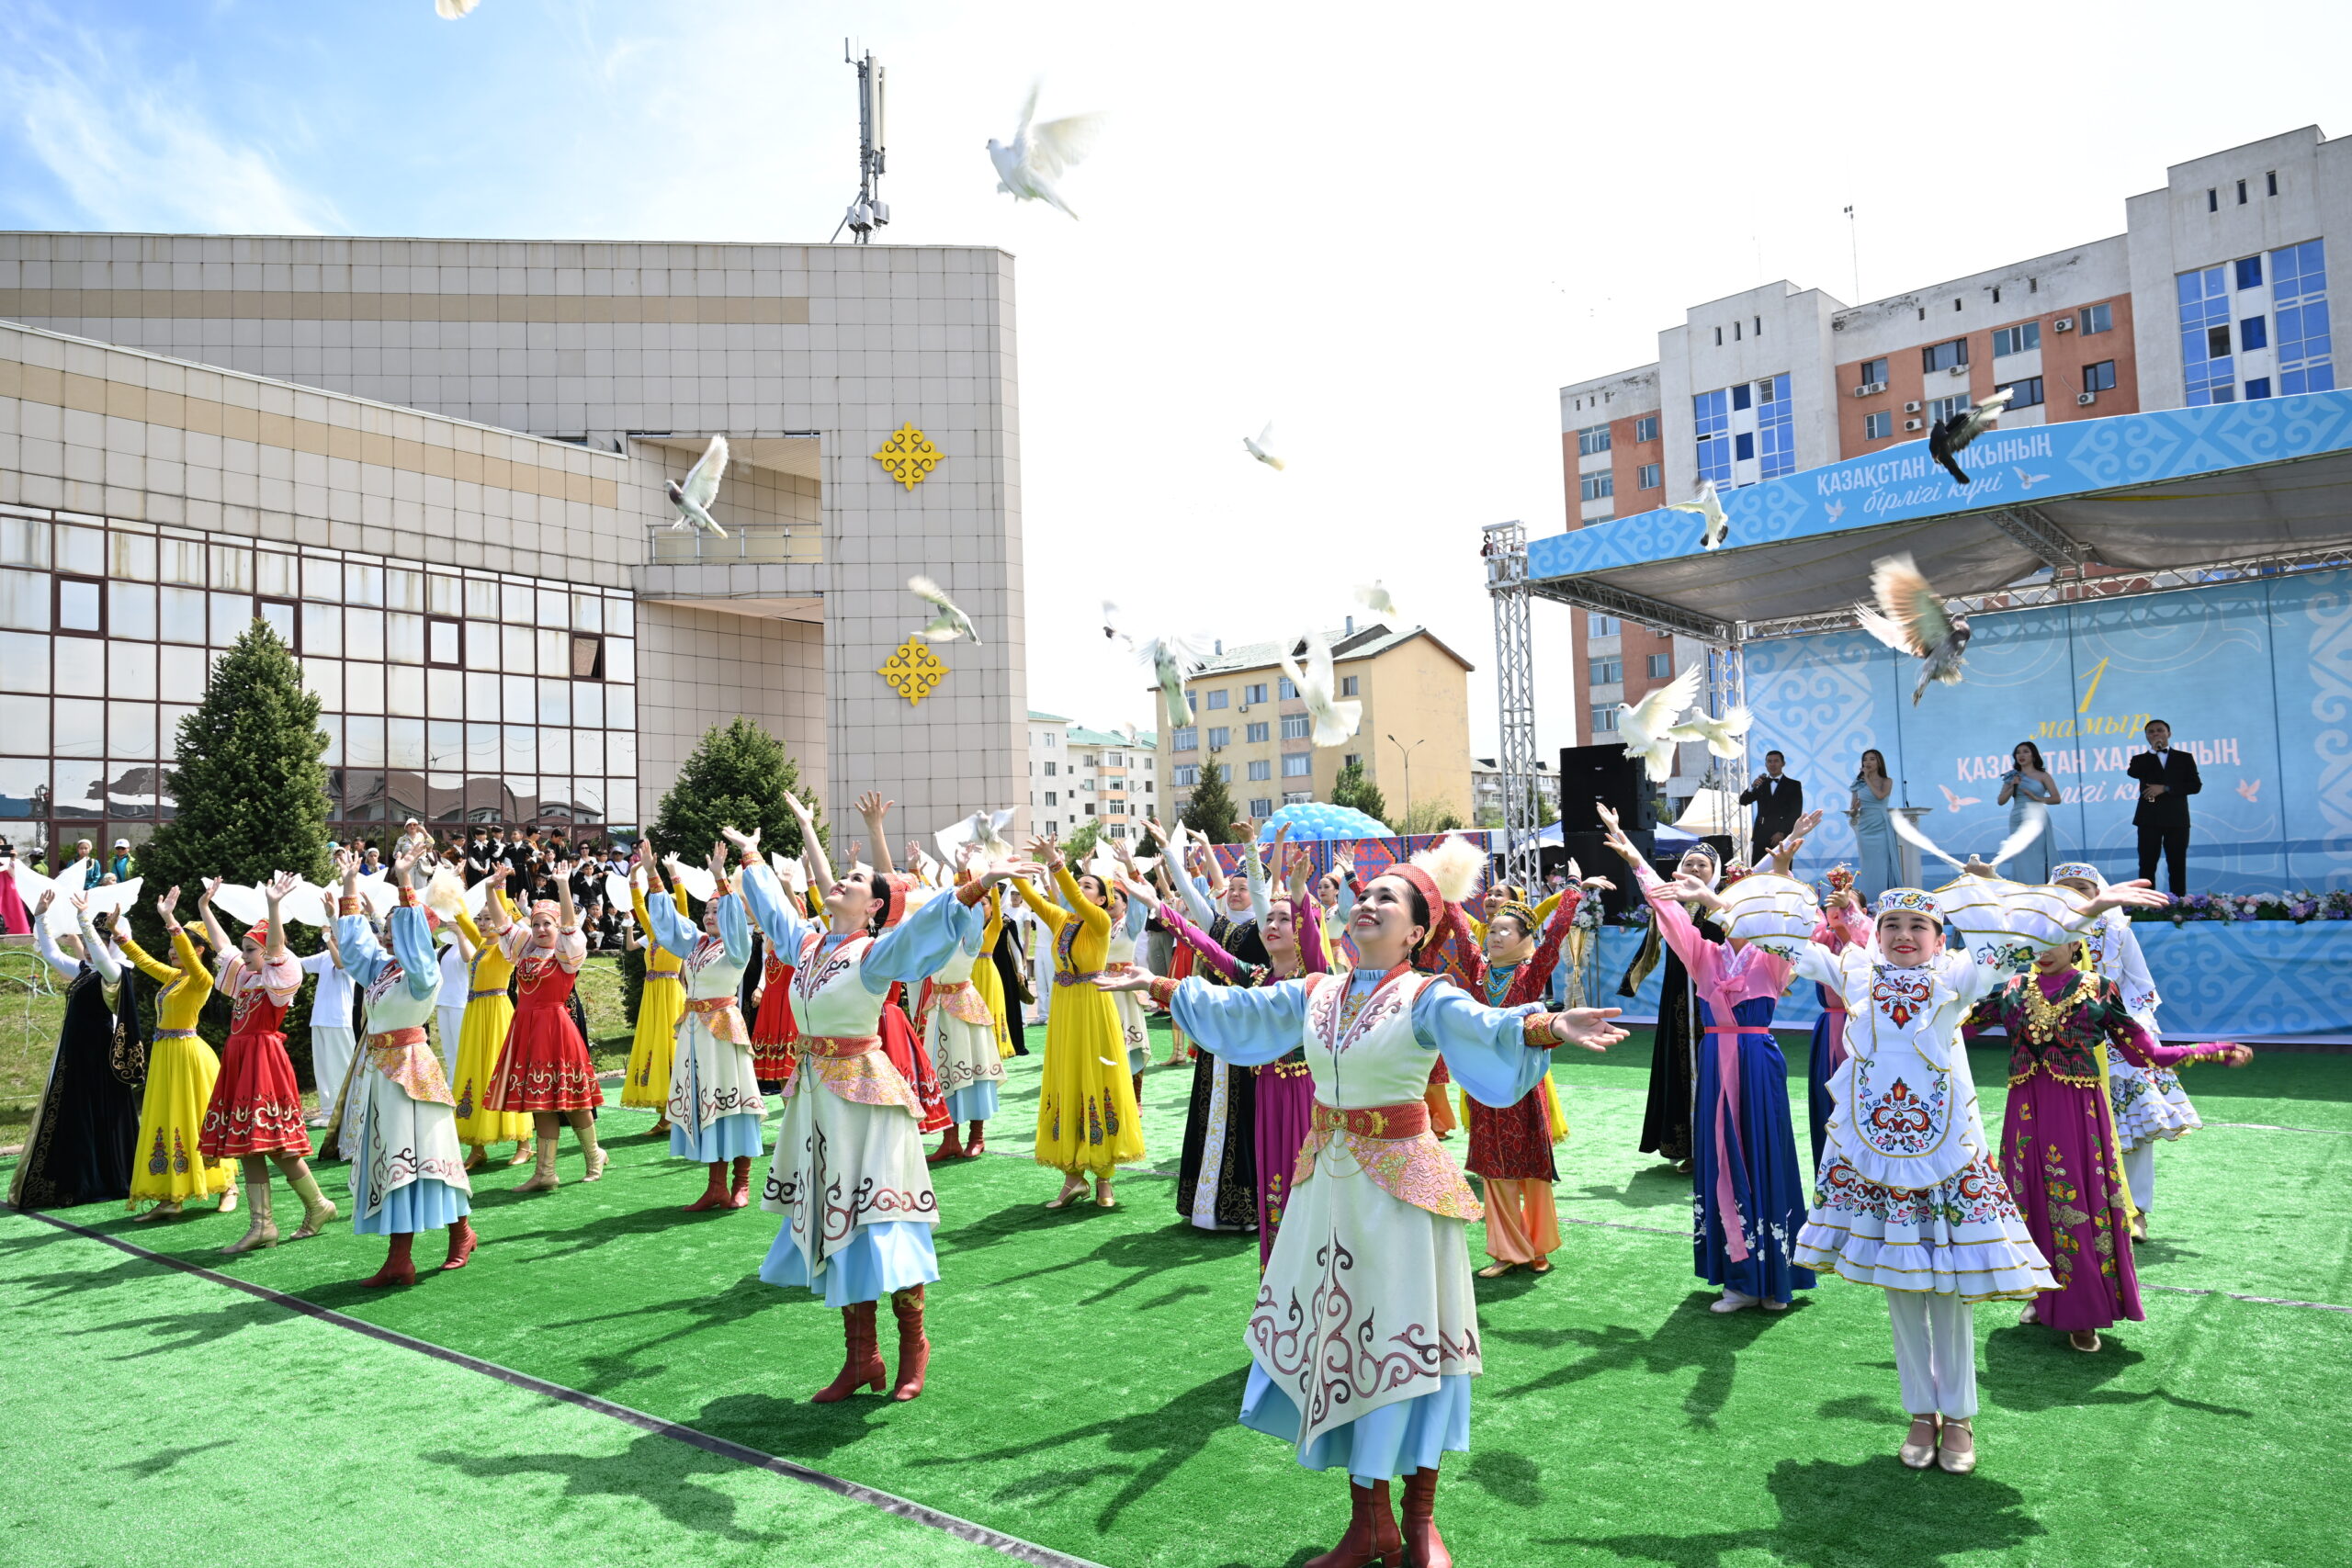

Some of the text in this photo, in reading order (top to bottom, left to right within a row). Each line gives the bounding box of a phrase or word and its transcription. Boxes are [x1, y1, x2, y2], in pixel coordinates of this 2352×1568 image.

[1816, 433, 2052, 497] ҚАЗАҚСТАН ХЛҚЫНЫҢ
[1862, 482, 1942, 517] бірлігі
[2077, 656, 2110, 714] 1
[2029, 712, 2152, 740] мамыр
[1956, 748, 2087, 784] ҚАЗАТАН
